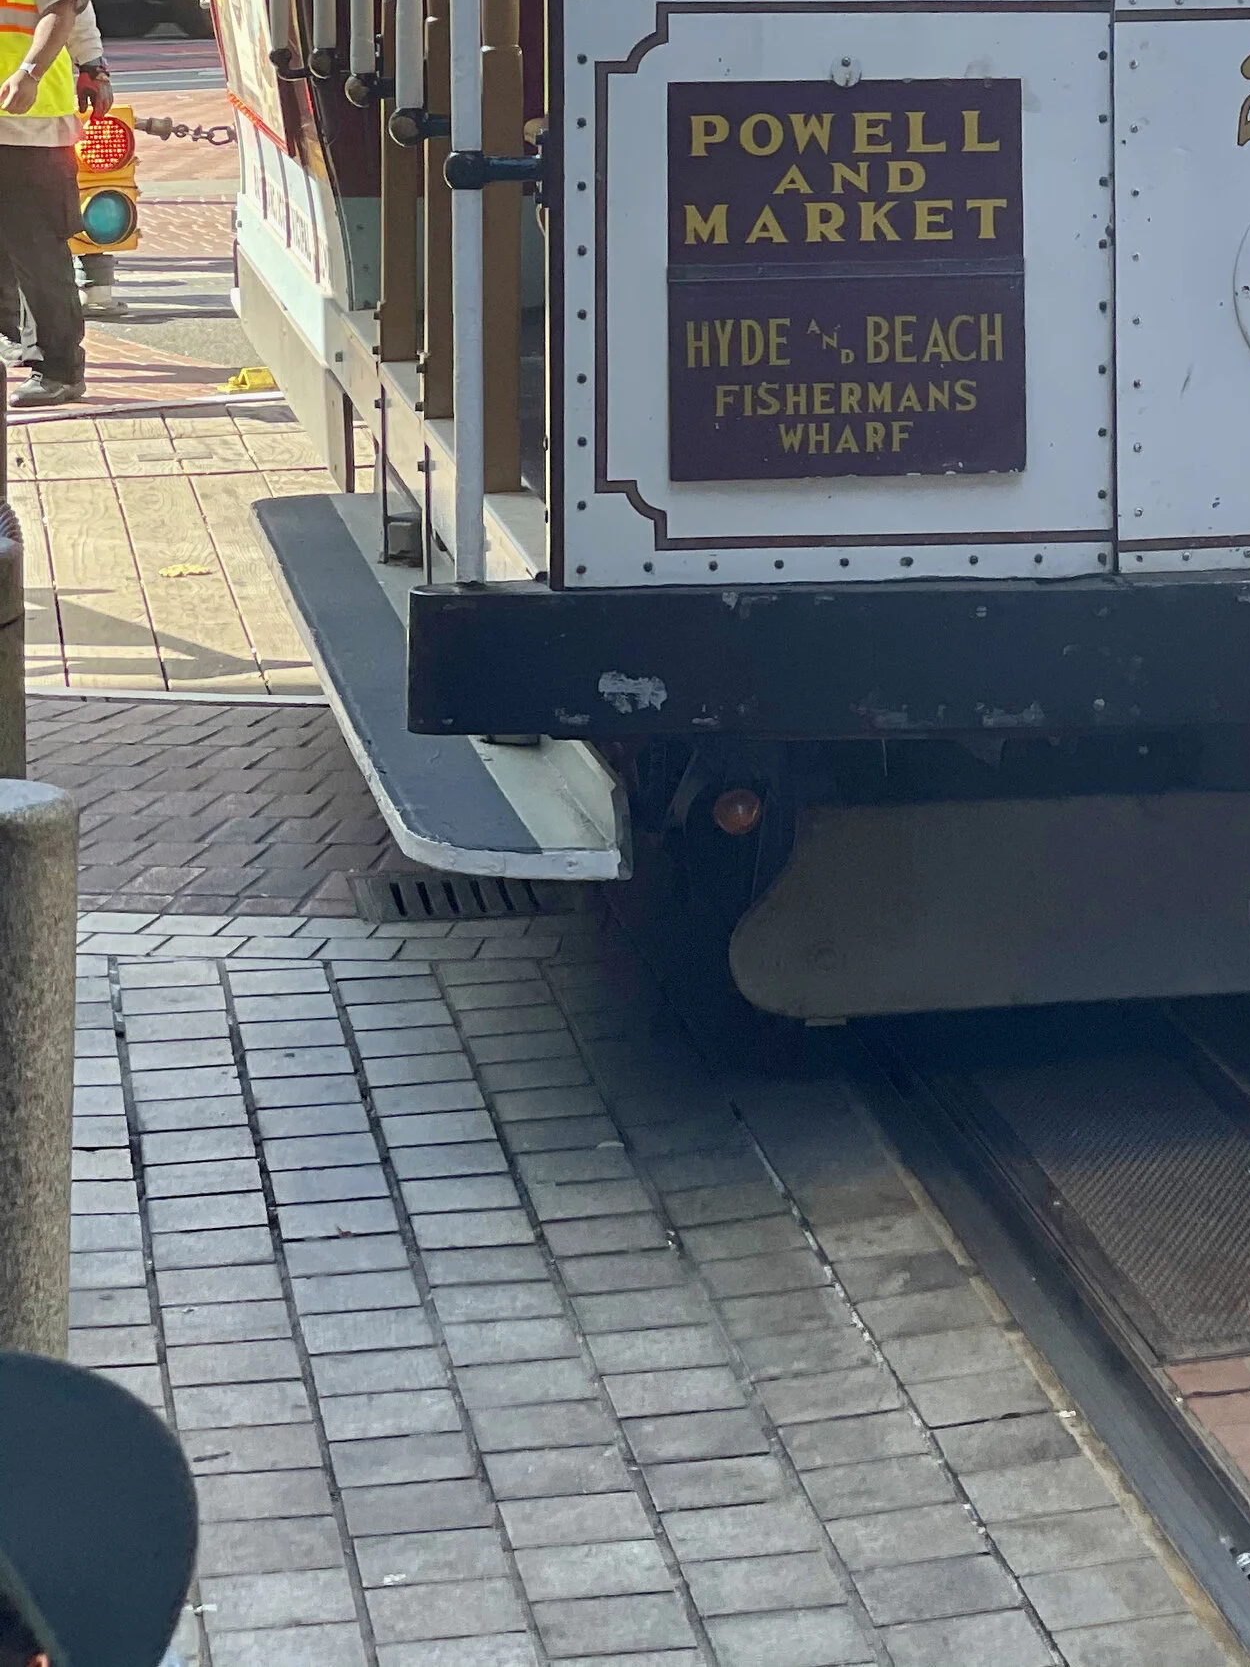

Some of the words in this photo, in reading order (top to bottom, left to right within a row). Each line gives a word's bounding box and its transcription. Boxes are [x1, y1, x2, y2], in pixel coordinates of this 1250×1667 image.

[689, 109, 1001, 157] POWELL
[772, 160, 927, 195] AND
[683, 198, 1008, 245] MARKET
[685, 317, 792, 369] HYDE
[806, 317, 856, 365] AND
[865, 312, 1005, 364] BEACH
[714, 379, 978, 417] FISHERMANS
[778, 420, 914, 454] WHARF
